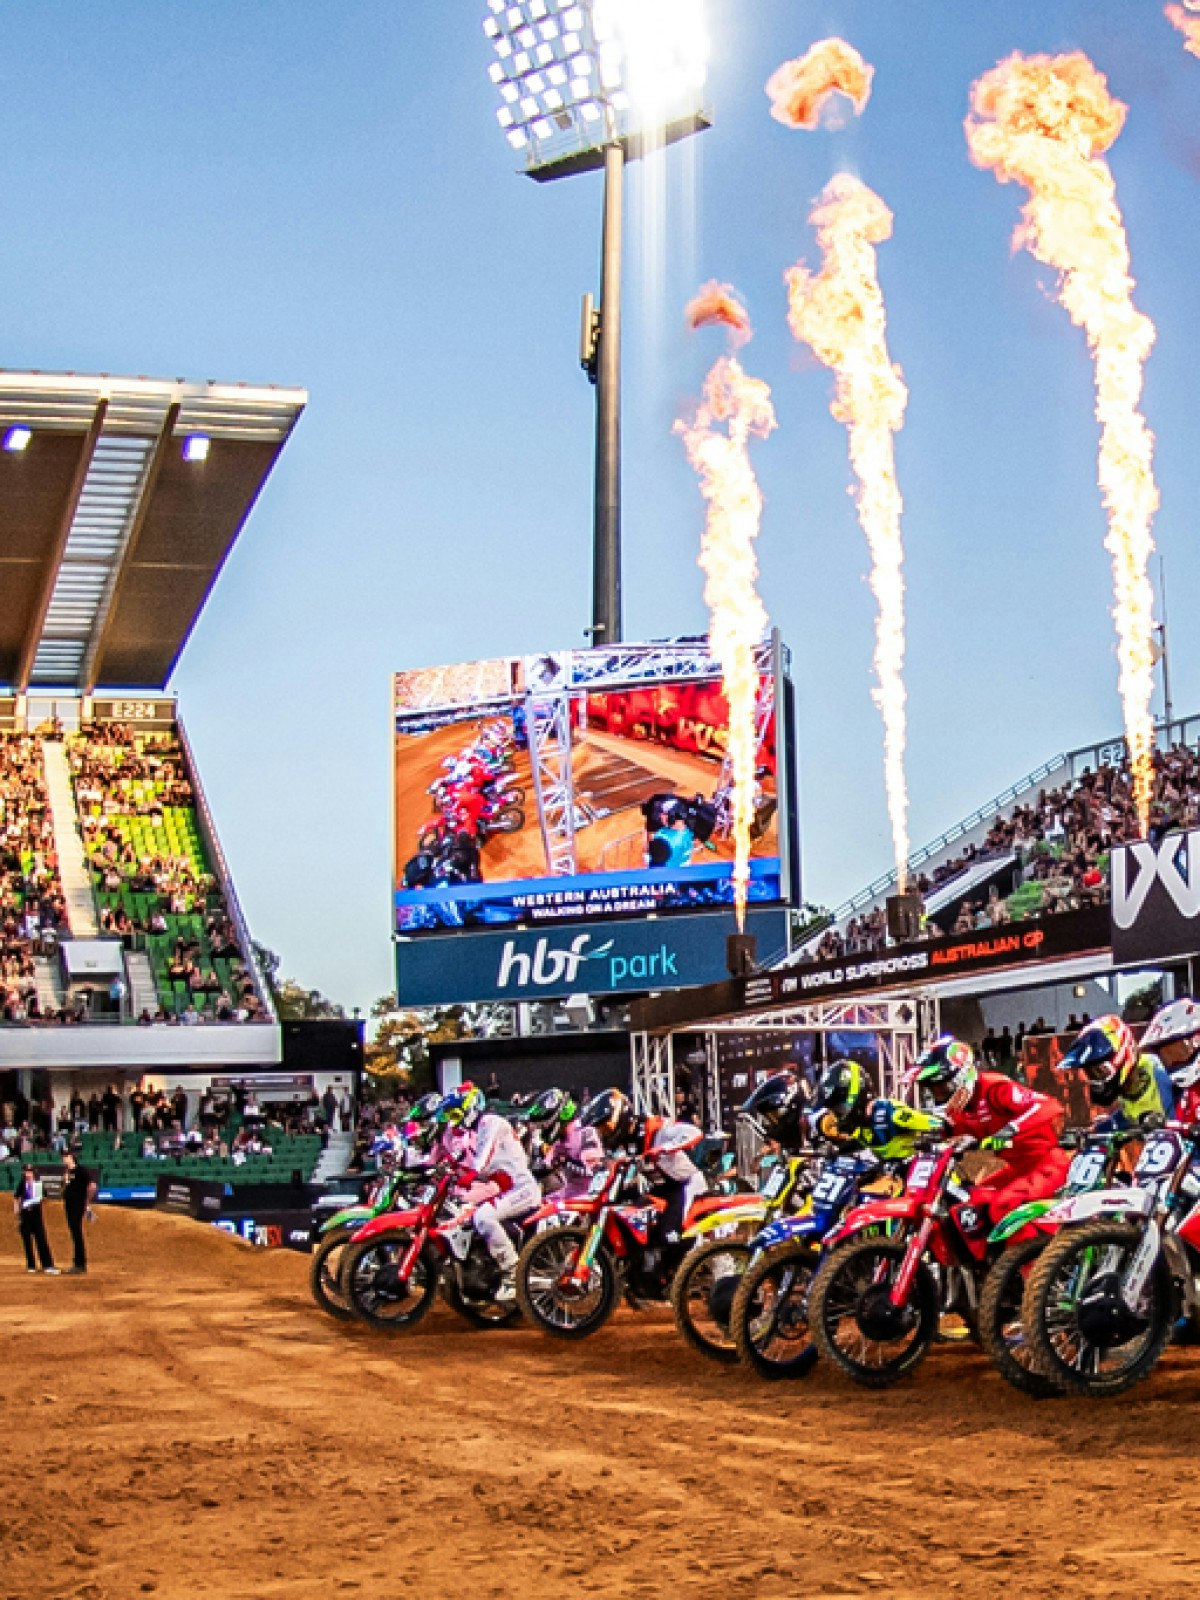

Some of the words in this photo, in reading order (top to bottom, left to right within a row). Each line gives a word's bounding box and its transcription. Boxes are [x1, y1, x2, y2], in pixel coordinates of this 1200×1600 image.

[112, 703, 156, 718] E224
[512, 889, 585, 907] WESTERN
[590, 882, 677, 901] AUSTRALIA
[532, 904, 584, 918] WALKING
[585, 903, 602, 914] ON
[614, 898, 657, 911] DREAM
[497, 933, 592, 988] hbf
[610, 943, 679, 988] park
[801, 967, 844, 989] WORLD
[845, 952, 929, 980] SUPERCROSS
[930, 934, 1020, 966] AUSTRALIAN
[1023, 929, 1045, 948] GP
[812, 1172, 847, 1203] 21
